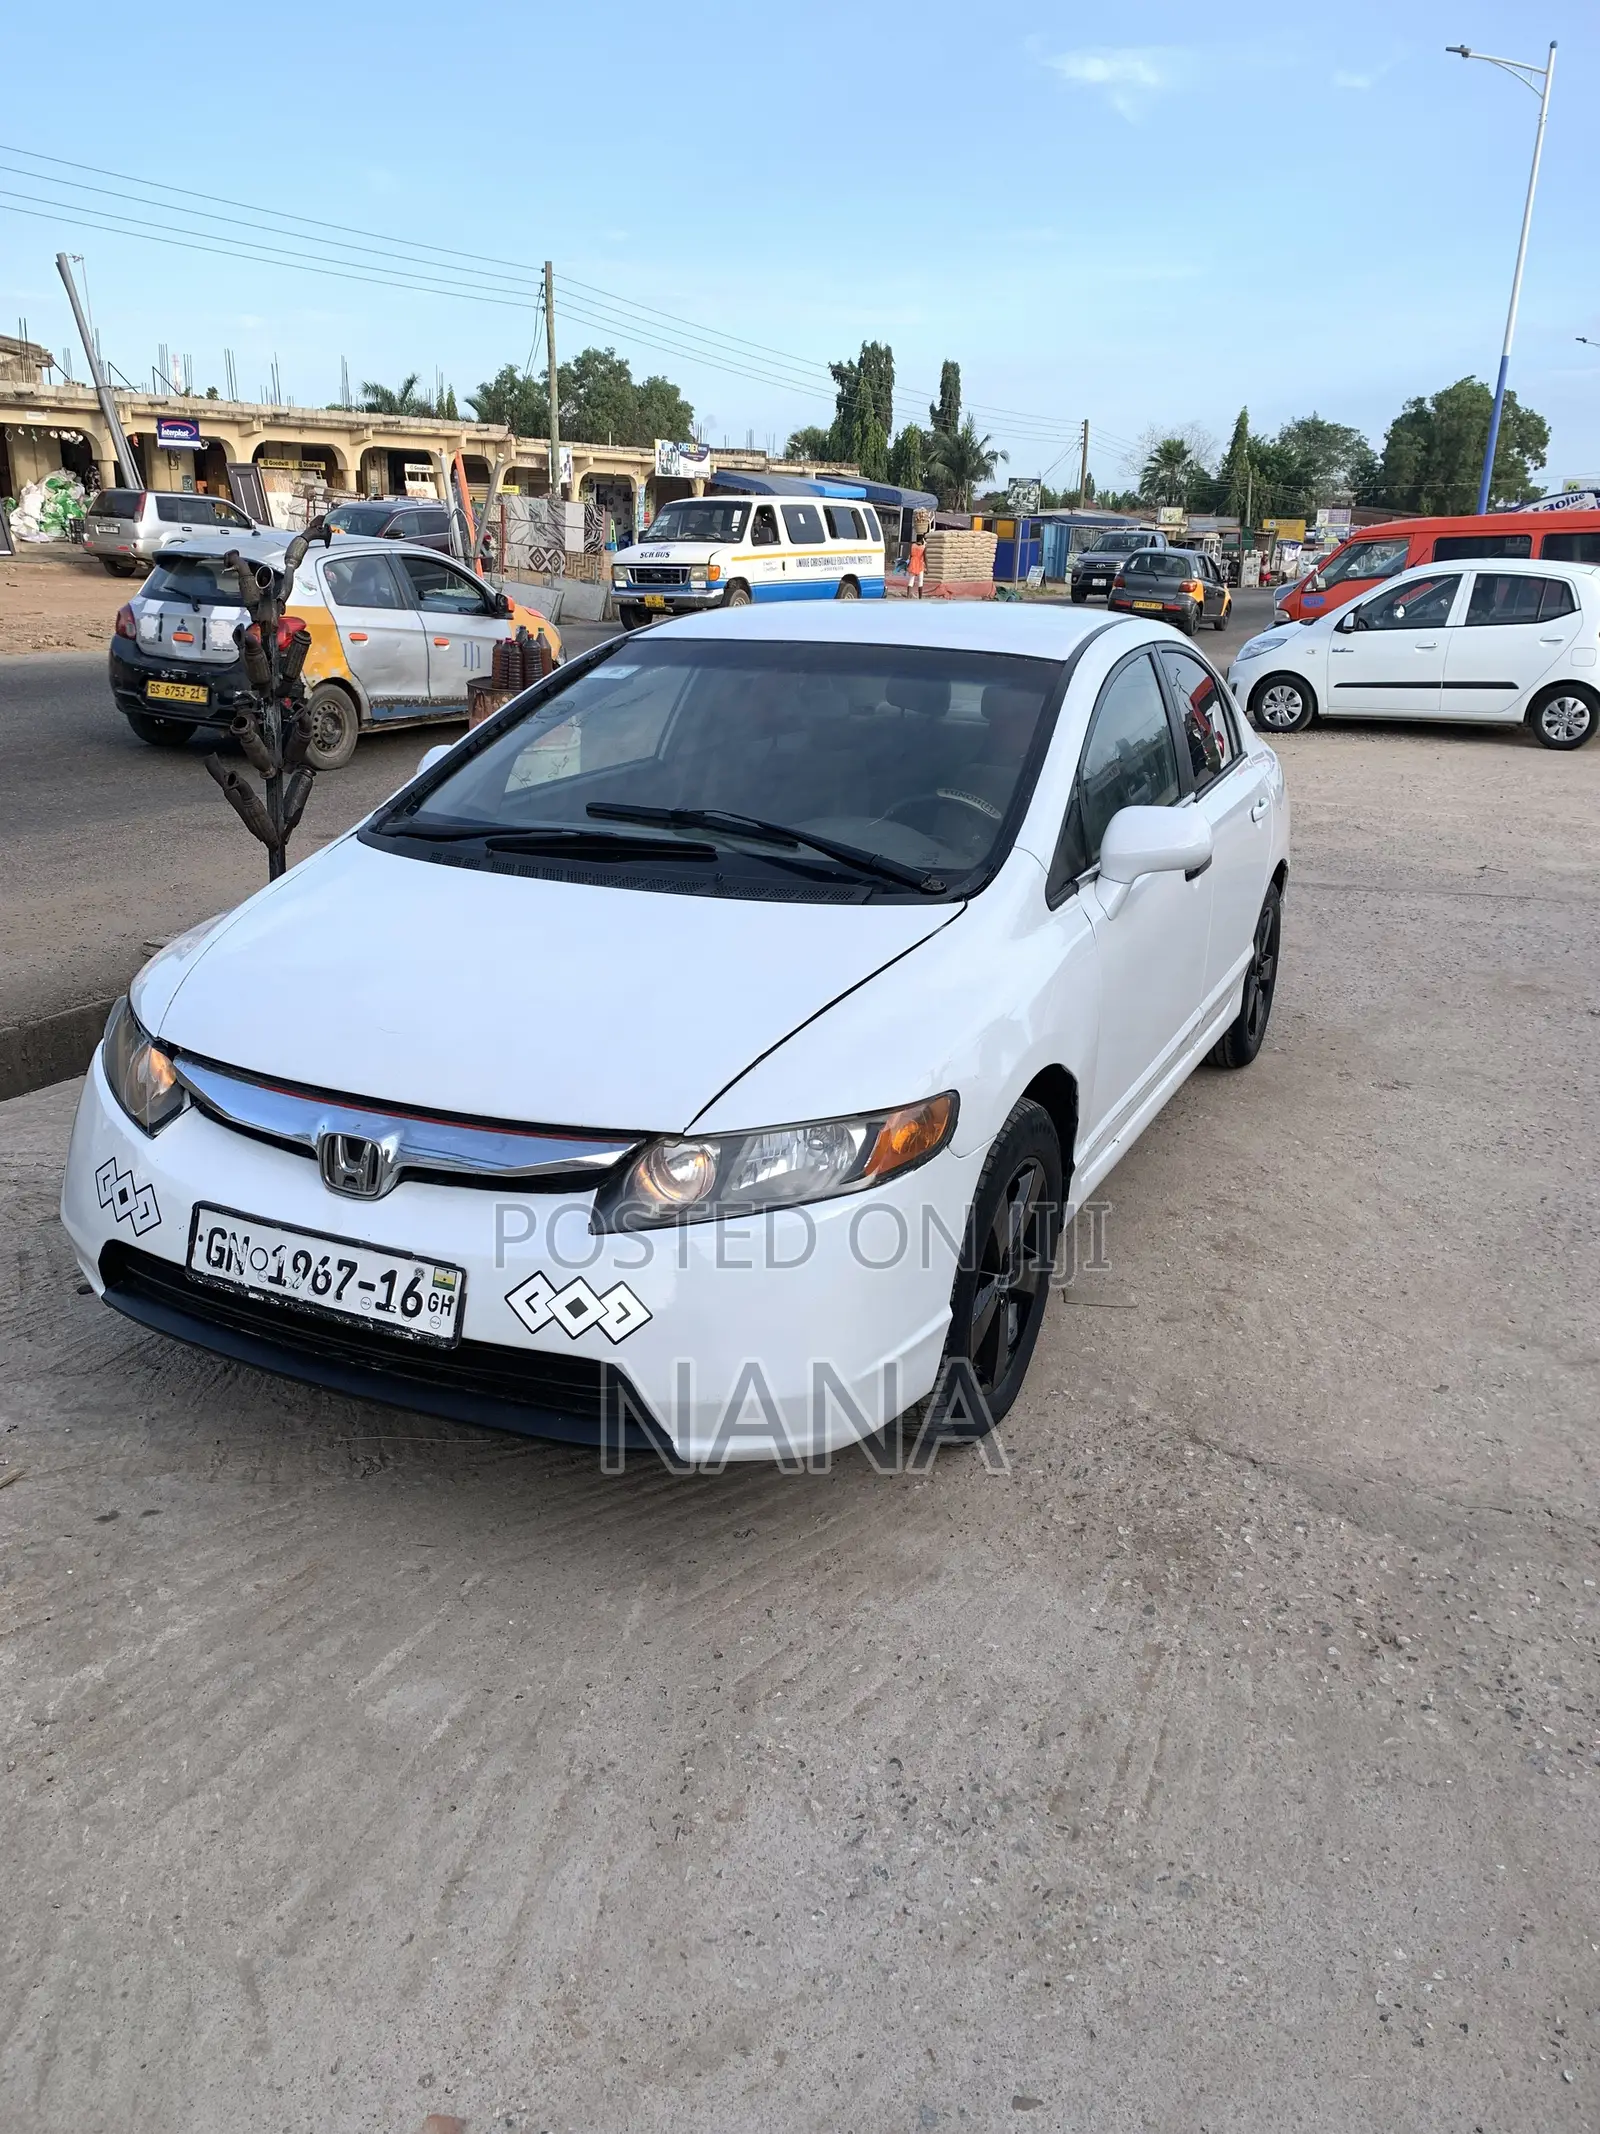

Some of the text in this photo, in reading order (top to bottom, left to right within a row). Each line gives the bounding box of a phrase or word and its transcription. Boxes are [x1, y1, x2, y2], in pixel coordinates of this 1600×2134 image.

[150, 683, 161, 694] GS
[205, 1226, 423, 1319] GN 1967-16
[427, 1291, 453, 1318] GH
